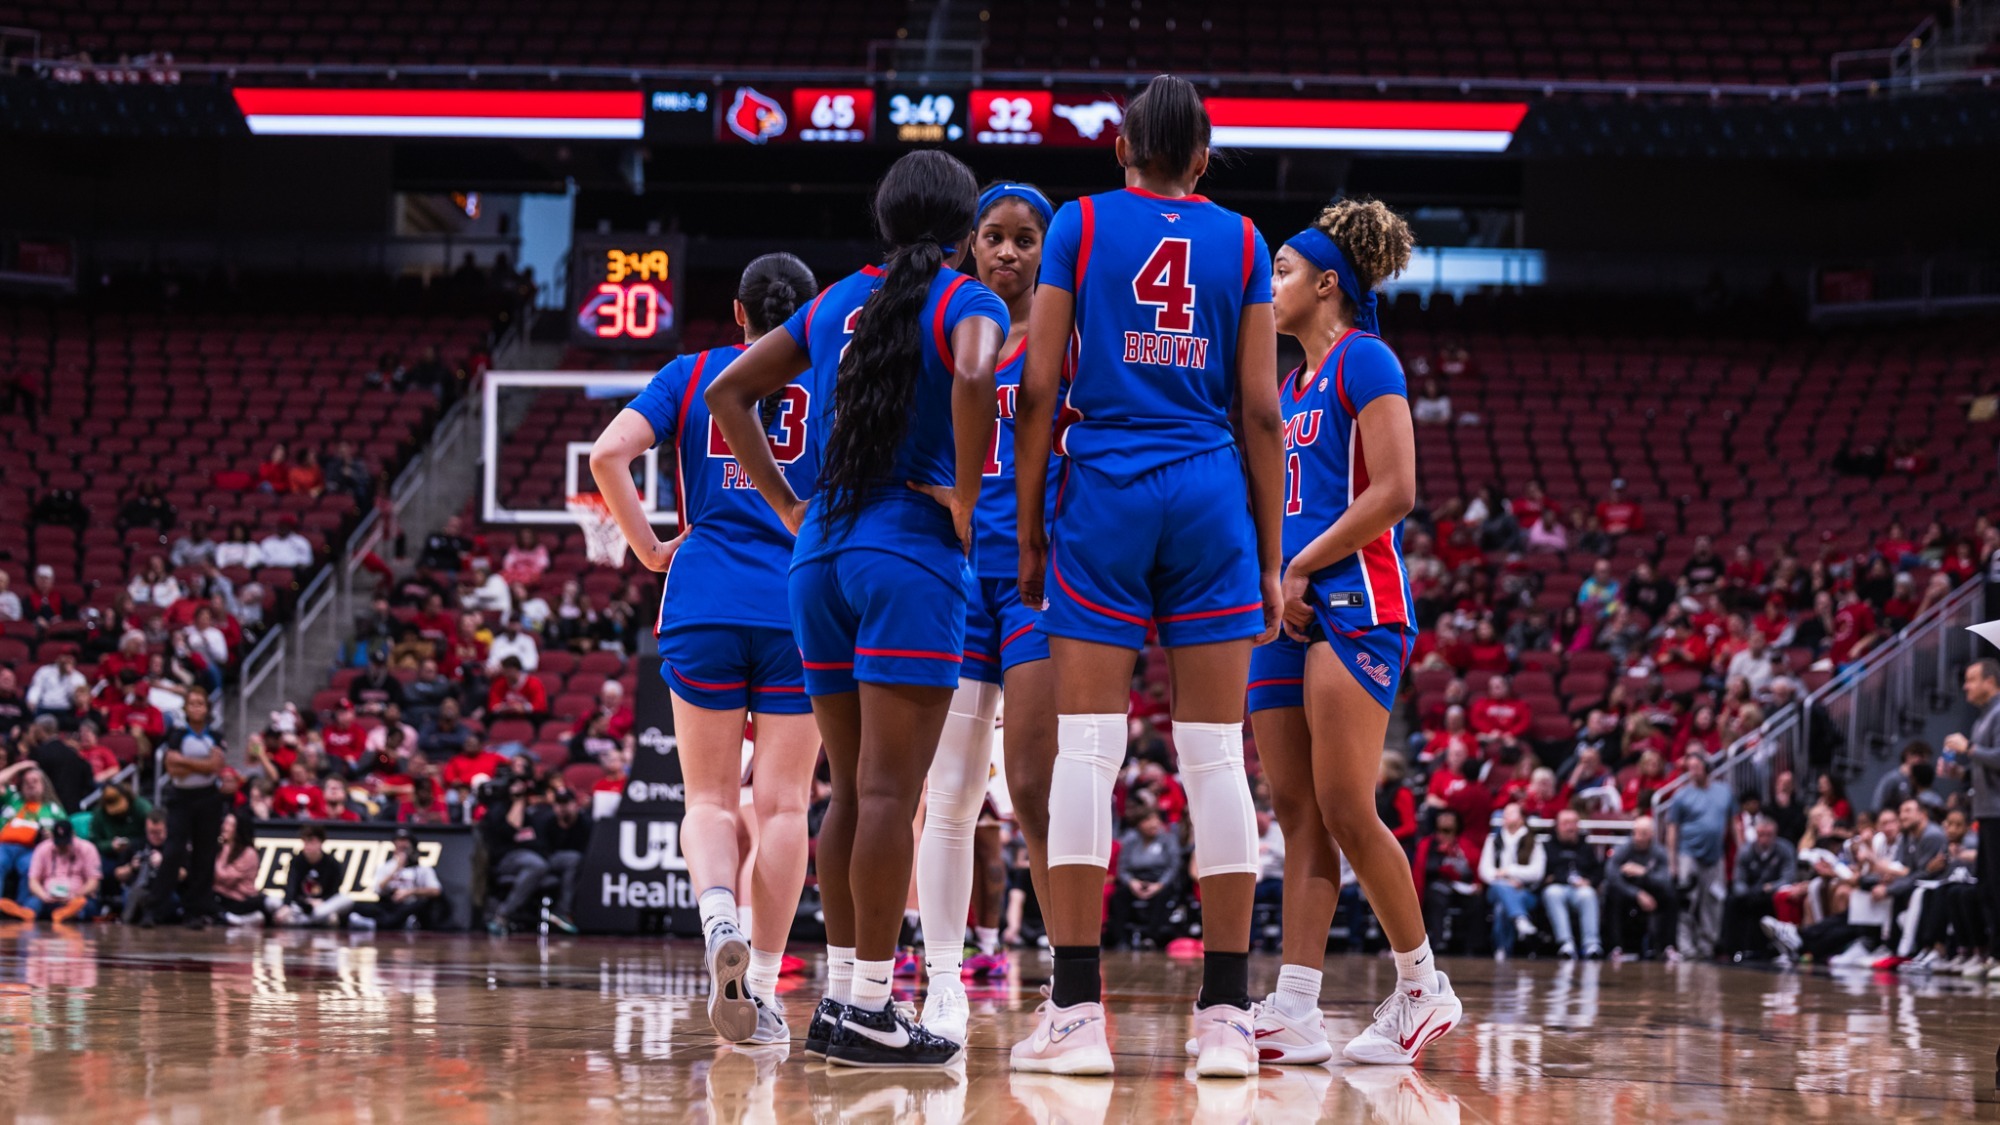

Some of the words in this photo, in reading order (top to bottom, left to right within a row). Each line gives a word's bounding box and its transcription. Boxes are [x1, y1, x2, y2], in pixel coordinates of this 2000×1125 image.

[811, 95, 855, 128] 65
[889, 94, 955, 125] 3:49
[988, 97, 1033, 132] 32
[607, 249, 669, 283] 3:49
[1131, 237, 1196, 334] 4
[596, 283, 657, 339] 30
[1123, 331, 1209, 369] BROWN
[1281, 409, 1324, 450] MU
[1355, 652, 1391, 687] Dallas
